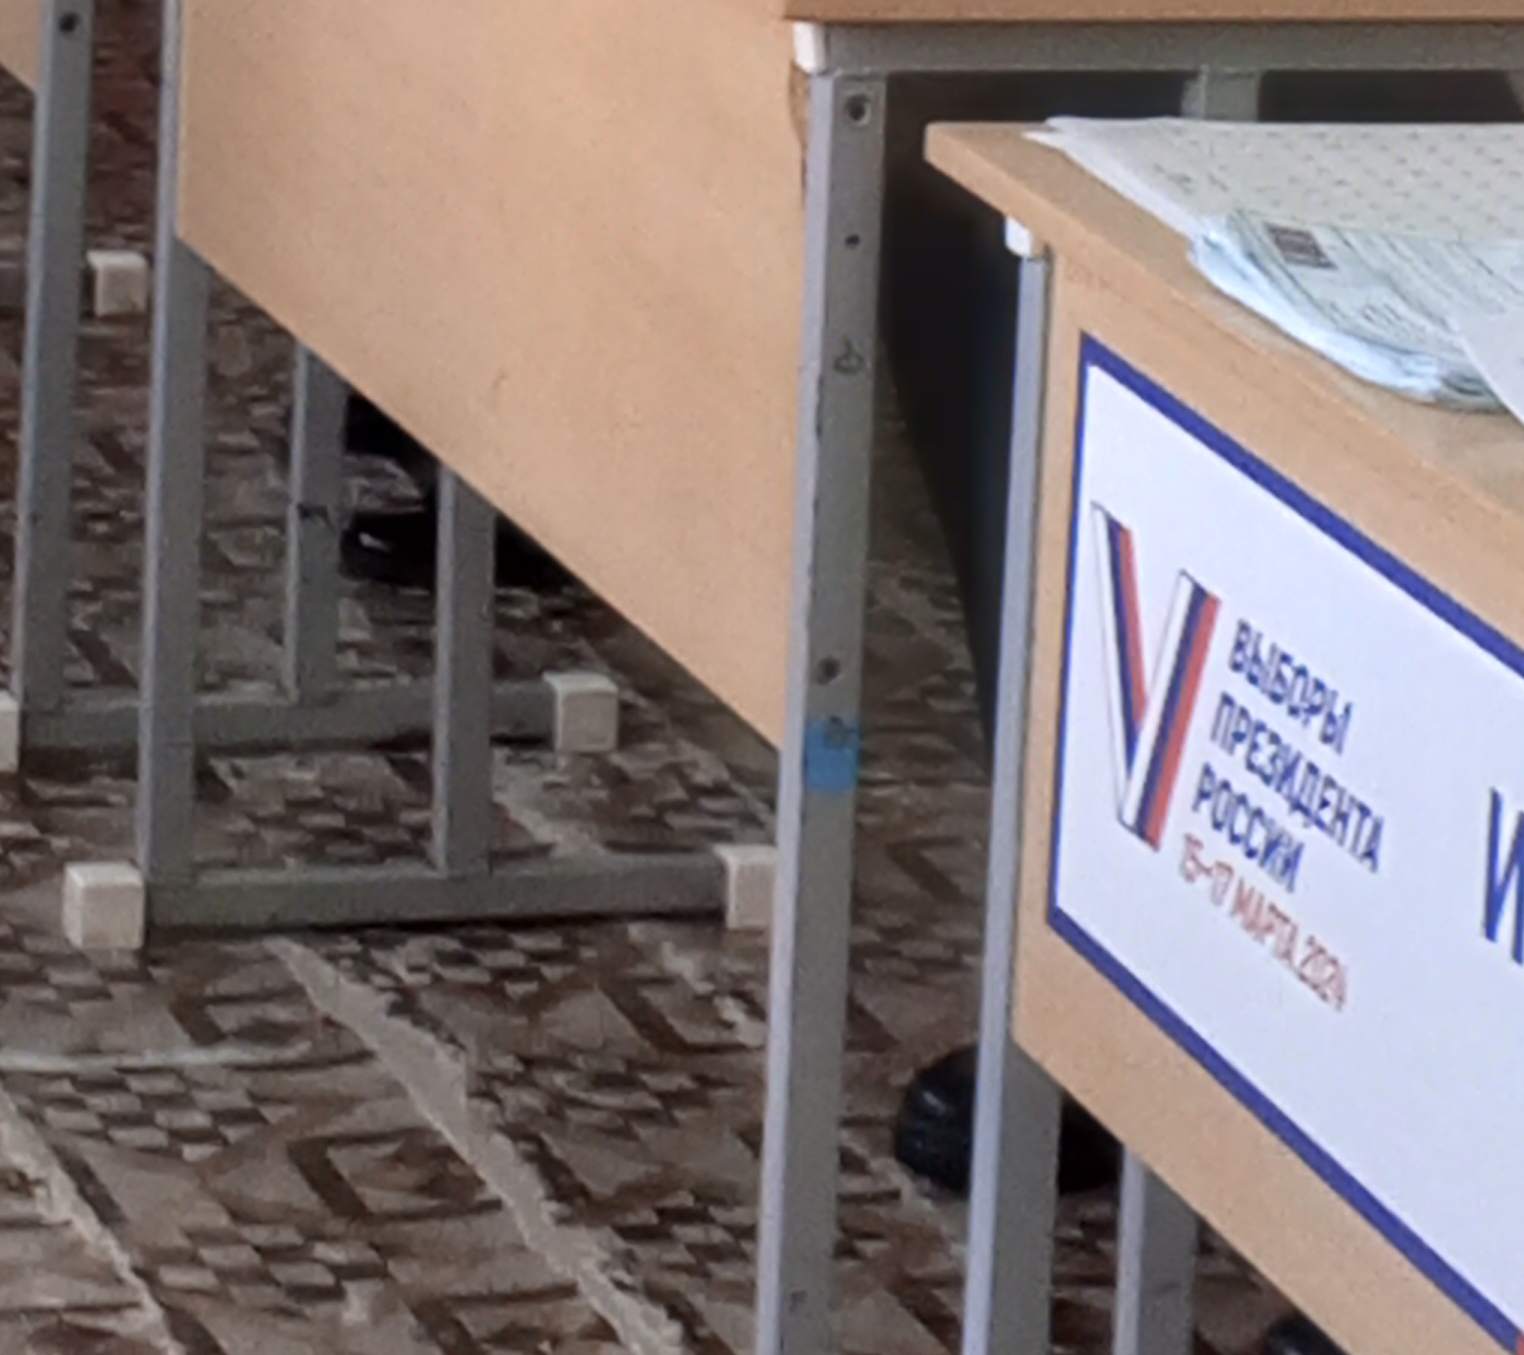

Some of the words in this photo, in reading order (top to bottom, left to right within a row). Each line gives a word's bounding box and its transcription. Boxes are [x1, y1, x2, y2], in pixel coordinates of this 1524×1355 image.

[1228, 617, 1354, 756] ВЫБОРЫ
[1192, 762, 1306, 894] РОССИИ
[1210, 690, 1385, 874] ПРЕЗИДЕНТА
[1231, 875, 1300, 975] МАРТА
[1299, 934, 1349, 1012] 2024
